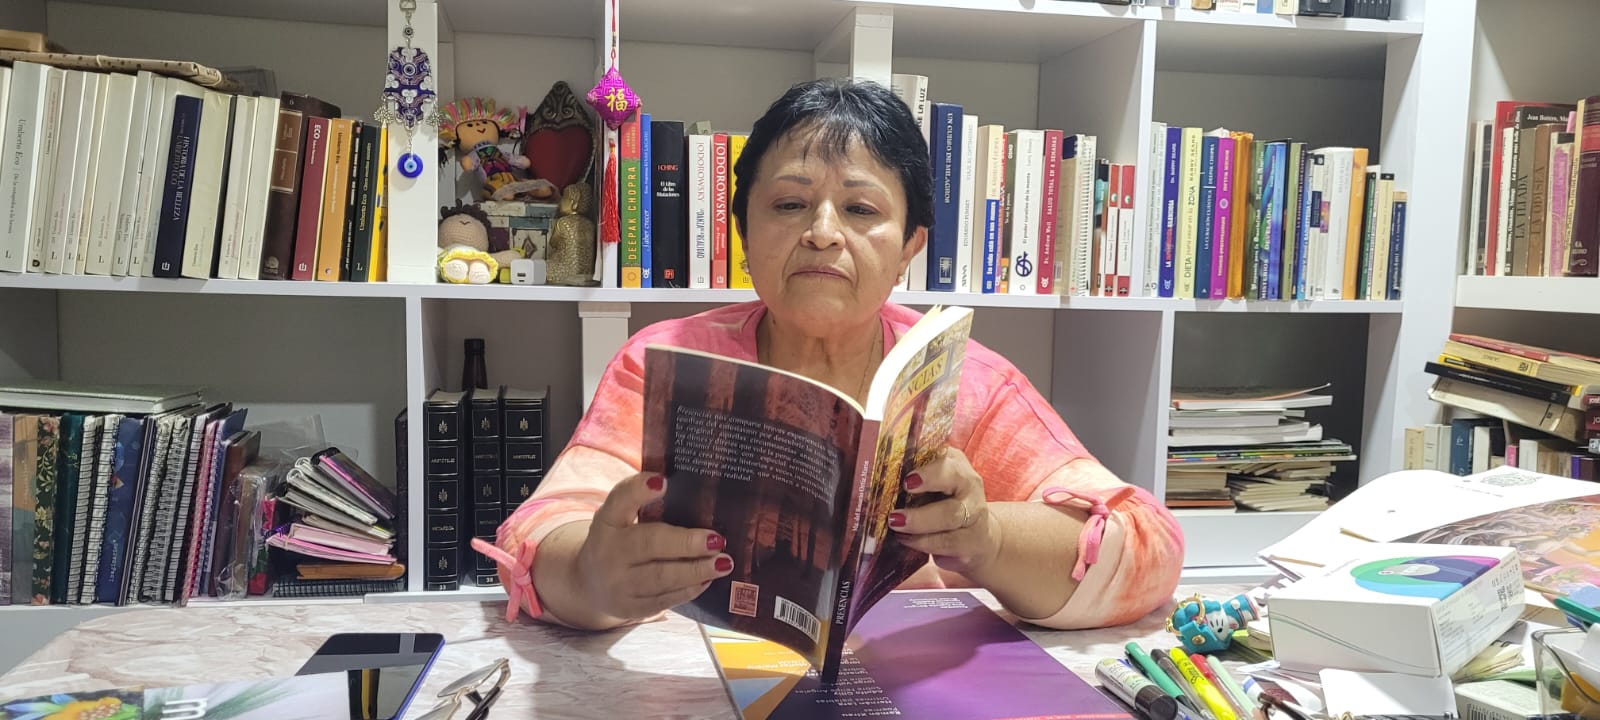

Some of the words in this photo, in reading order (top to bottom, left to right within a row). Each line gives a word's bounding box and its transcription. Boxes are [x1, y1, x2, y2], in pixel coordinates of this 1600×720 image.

[605, 88, 629, 113] 福
[946, 112, 953, 125] UN
[1527, 113, 1539, 121] Jean
[15, 119, 26, 152] Umberto
[313, 124, 321, 139] ECO
[945, 125, 953, 151] CURSO
[14, 151, 22, 166] Eco
[178, 136, 190, 169] HISTORIA
[945, 152, 952, 164] DE
[176, 179, 184, 190] LA
[697, 142, 705, 202] JODOROWSKY
[715, 142, 727, 225] JODOROWSKY
[944, 164, 952, 203] MILAGROS
[626, 166, 637, 211] CHOPRA
[1187, 185, 1196, 206] ZONA
[1531, 165, 1545, 215] ODISEA
[172, 190, 183, 221] BELLEZA
[359, 202, 368, 231] Umberto
[696, 212, 705, 229] DANZA
[1264, 202, 1273, 250] DEVELADOS
[1515, 223, 1526, 239] LA
[1531, 218, 1541, 235] LA
[626, 217, 637, 260] DEEPAK
[696, 234, 705, 259] REALIDAD
[1183, 257, 1193, 278] DIETA
[1261, 258, 1269, 299] MISTERIOS
[760, 454, 786, 467] especial
[858, 477, 866, 492] Ortiz
[834, 580, 851, 625] PRESENCIAS
